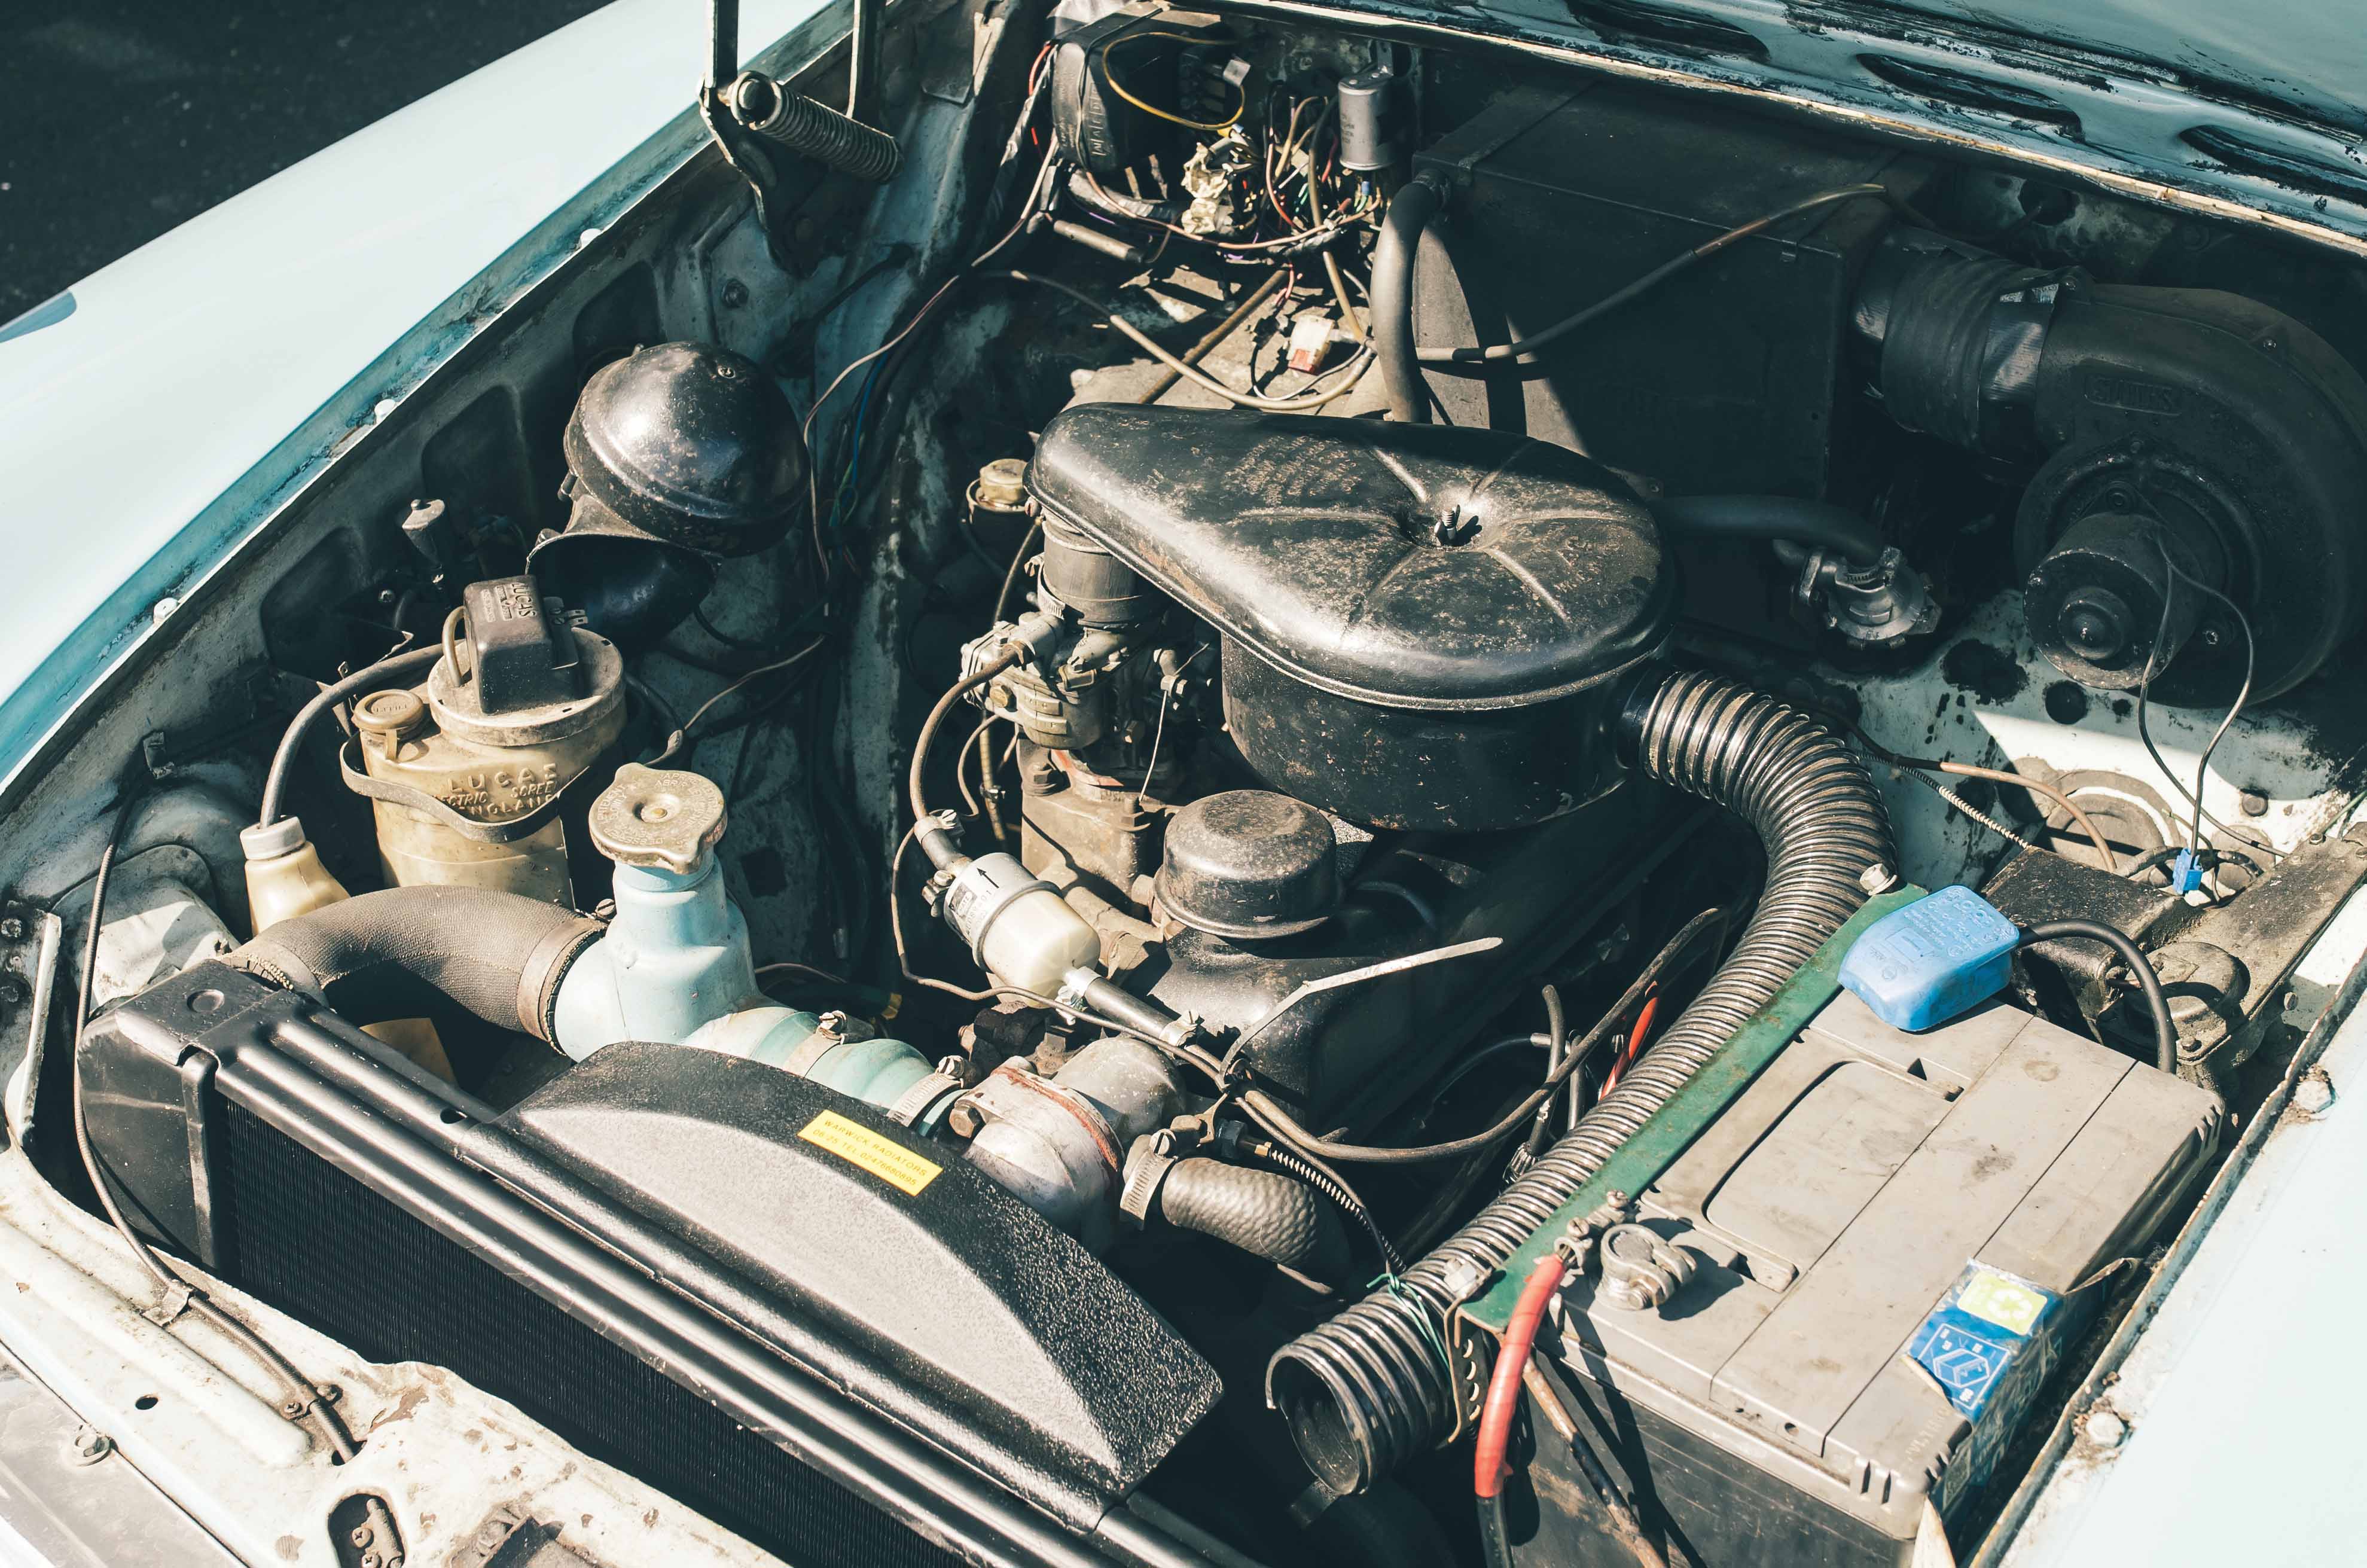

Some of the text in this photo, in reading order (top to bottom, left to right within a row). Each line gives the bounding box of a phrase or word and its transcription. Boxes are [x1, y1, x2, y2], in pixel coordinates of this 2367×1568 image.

[447, 762, 557, 794] LUCAS
[510, 780, 556, 798] SCREE
[459, 794, 553, 815] NGLAN
[824, 1119, 927, 1176] WARWICK RADIATORS
